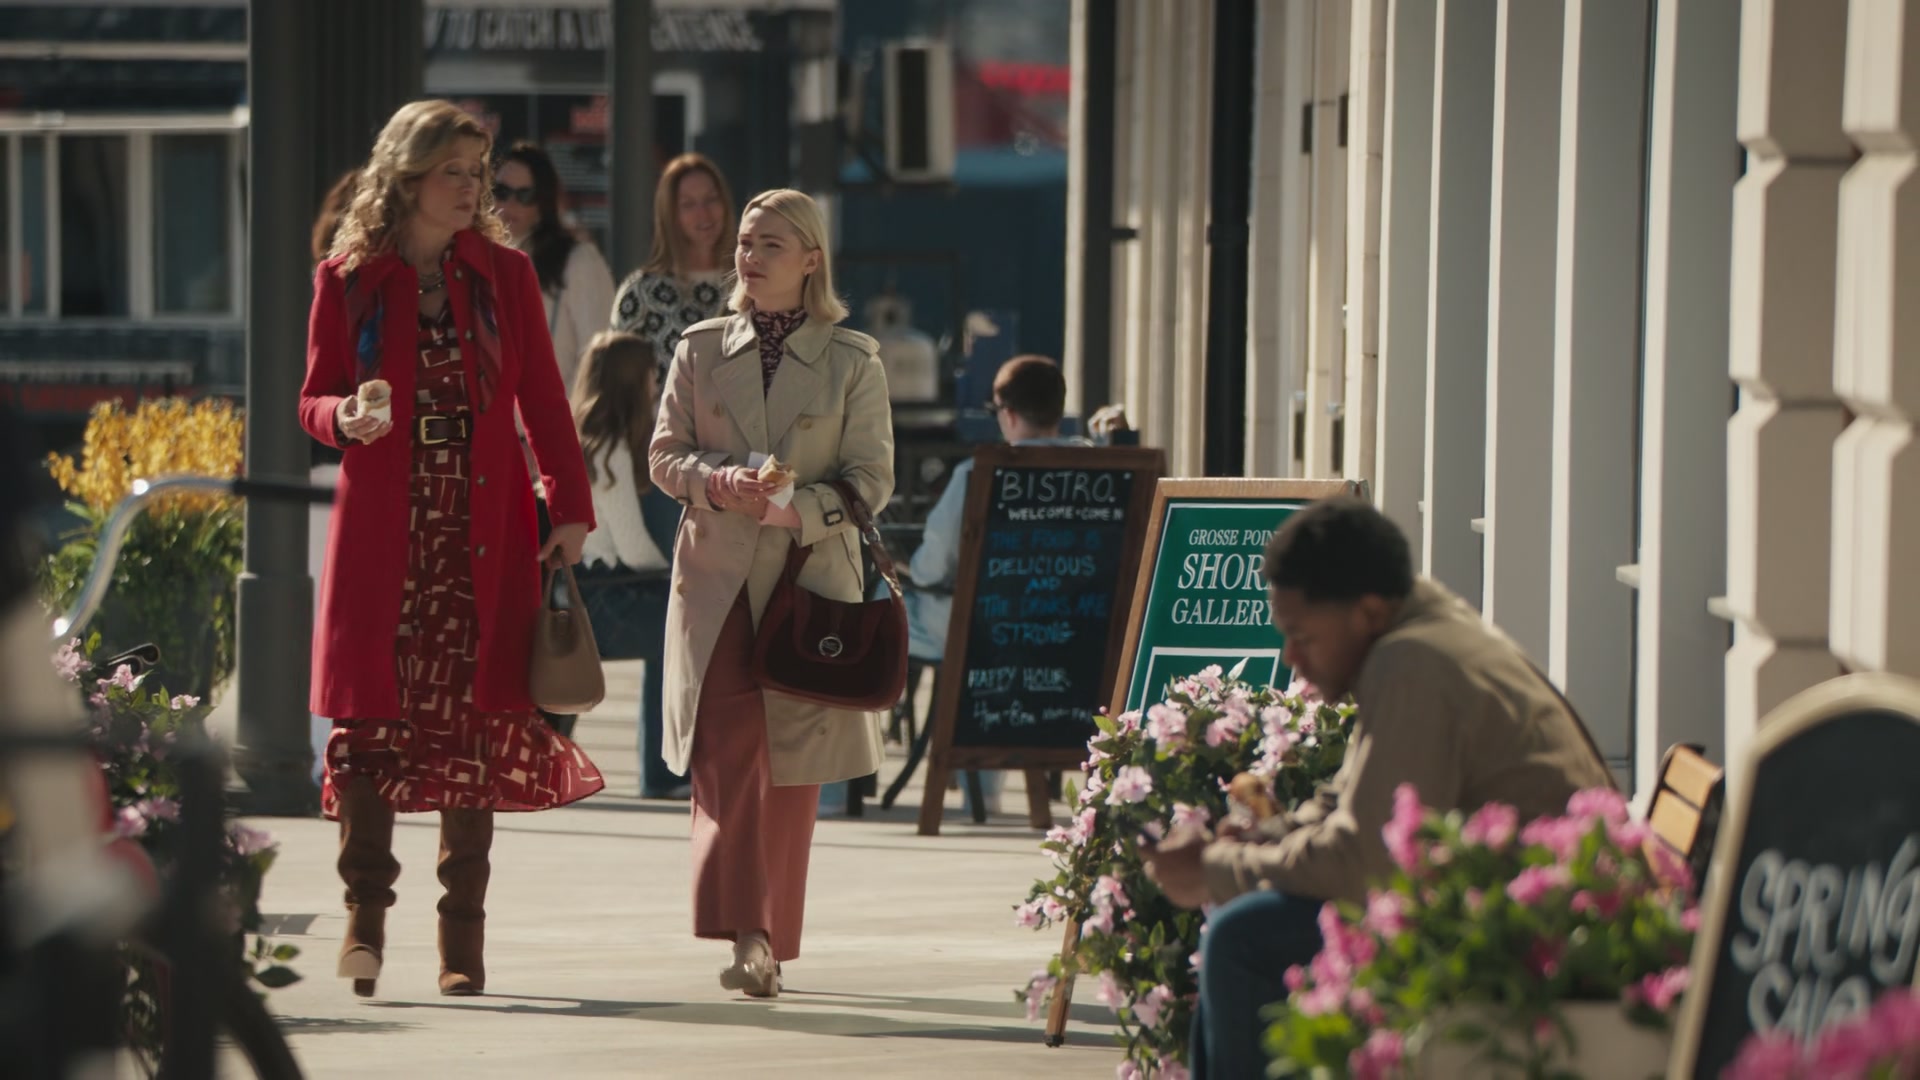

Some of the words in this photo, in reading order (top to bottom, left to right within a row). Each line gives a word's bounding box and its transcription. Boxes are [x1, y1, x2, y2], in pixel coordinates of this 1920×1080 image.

[478, 11, 555, 50] CATCH
[1188, 528, 1239, 546] GROSSE
[1241, 529, 1280, 546] POIN
[987, 553, 1097, 579] DELICIOUS
[1177, 553, 1273, 591] SHOR
[1024, 575, 1062, 595] AND
[1170, 598, 1274, 626] GALLERY
[991, 620, 1077, 647] STRONG
[967, 665, 1018, 690] HAPPY
[1022, 667, 1072, 689] HOUR
[1731, 835, 1920, 985] SPRING
